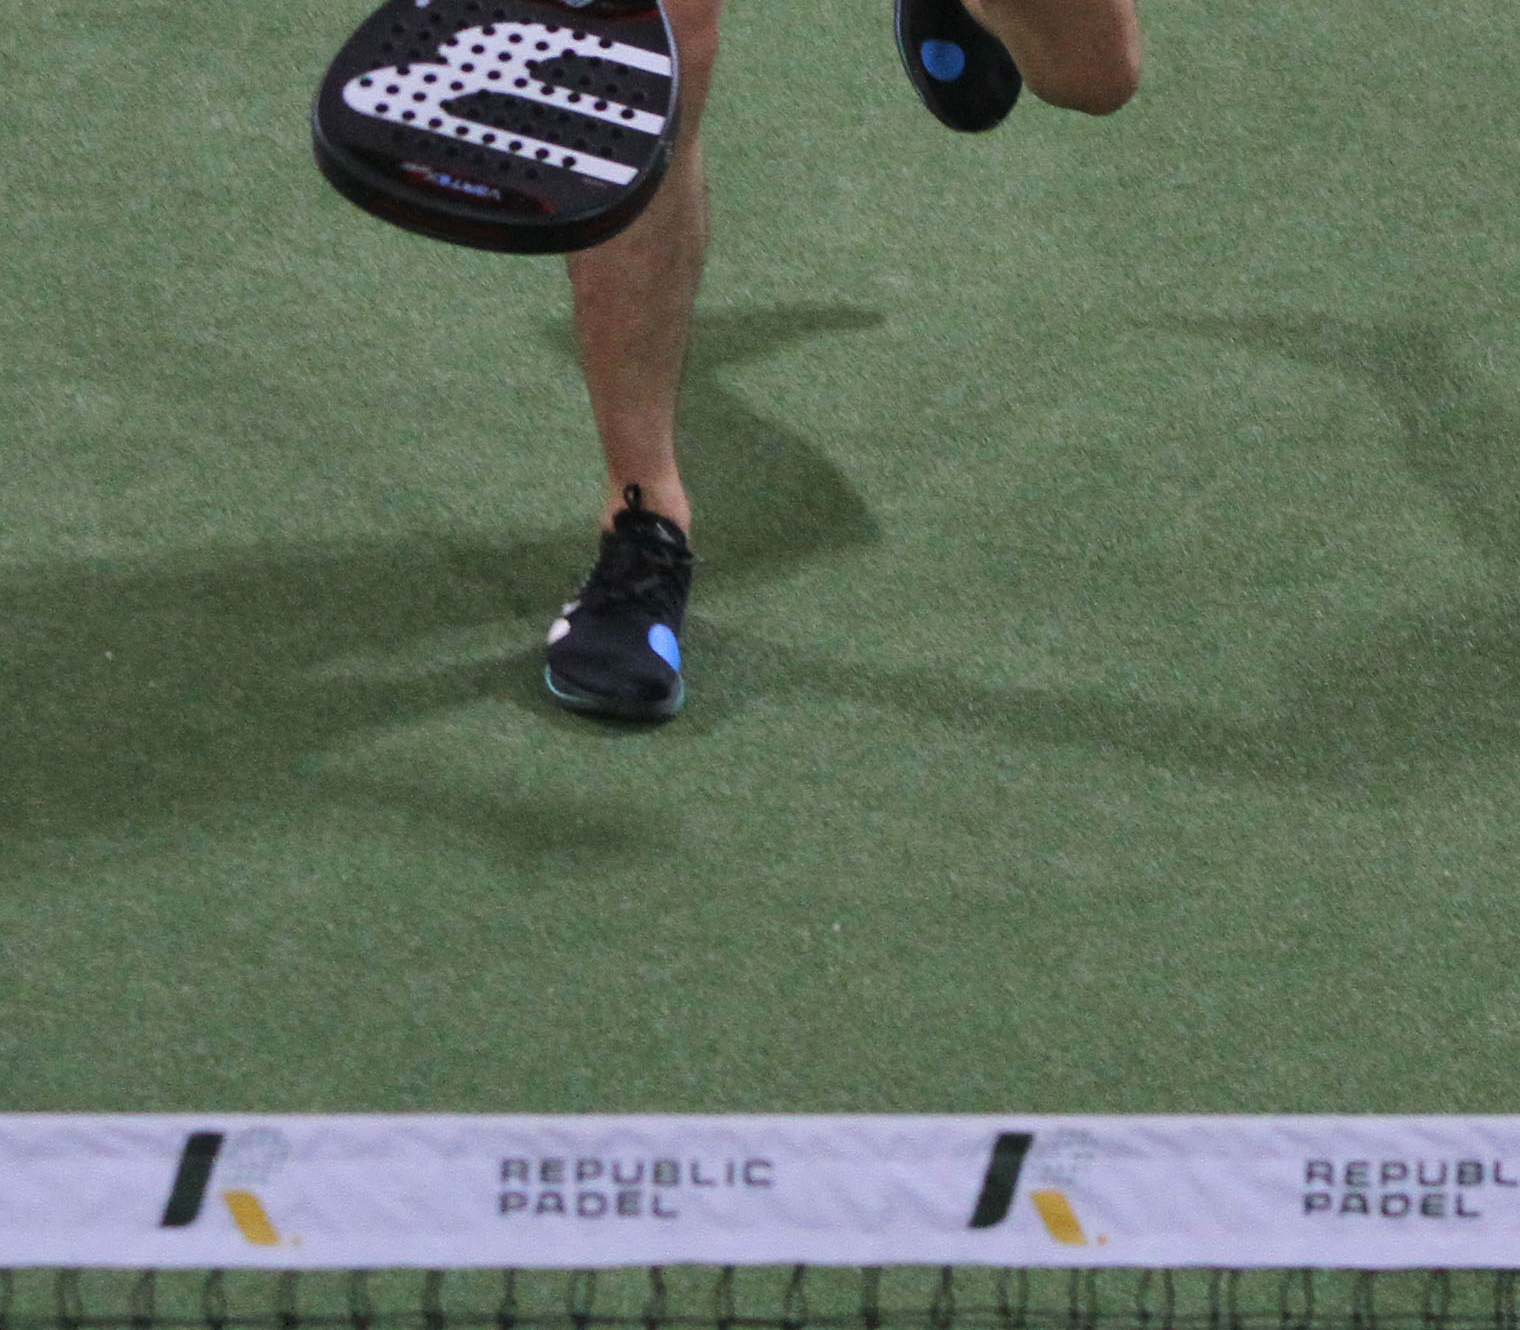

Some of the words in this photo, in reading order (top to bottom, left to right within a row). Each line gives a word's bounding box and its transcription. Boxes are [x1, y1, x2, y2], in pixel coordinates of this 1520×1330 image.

[500, 1158, 772, 1186] REPUBLIC
[498, 1190, 677, 1218] PADEL
[1302, 1191, 1480, 1219] PADEL
